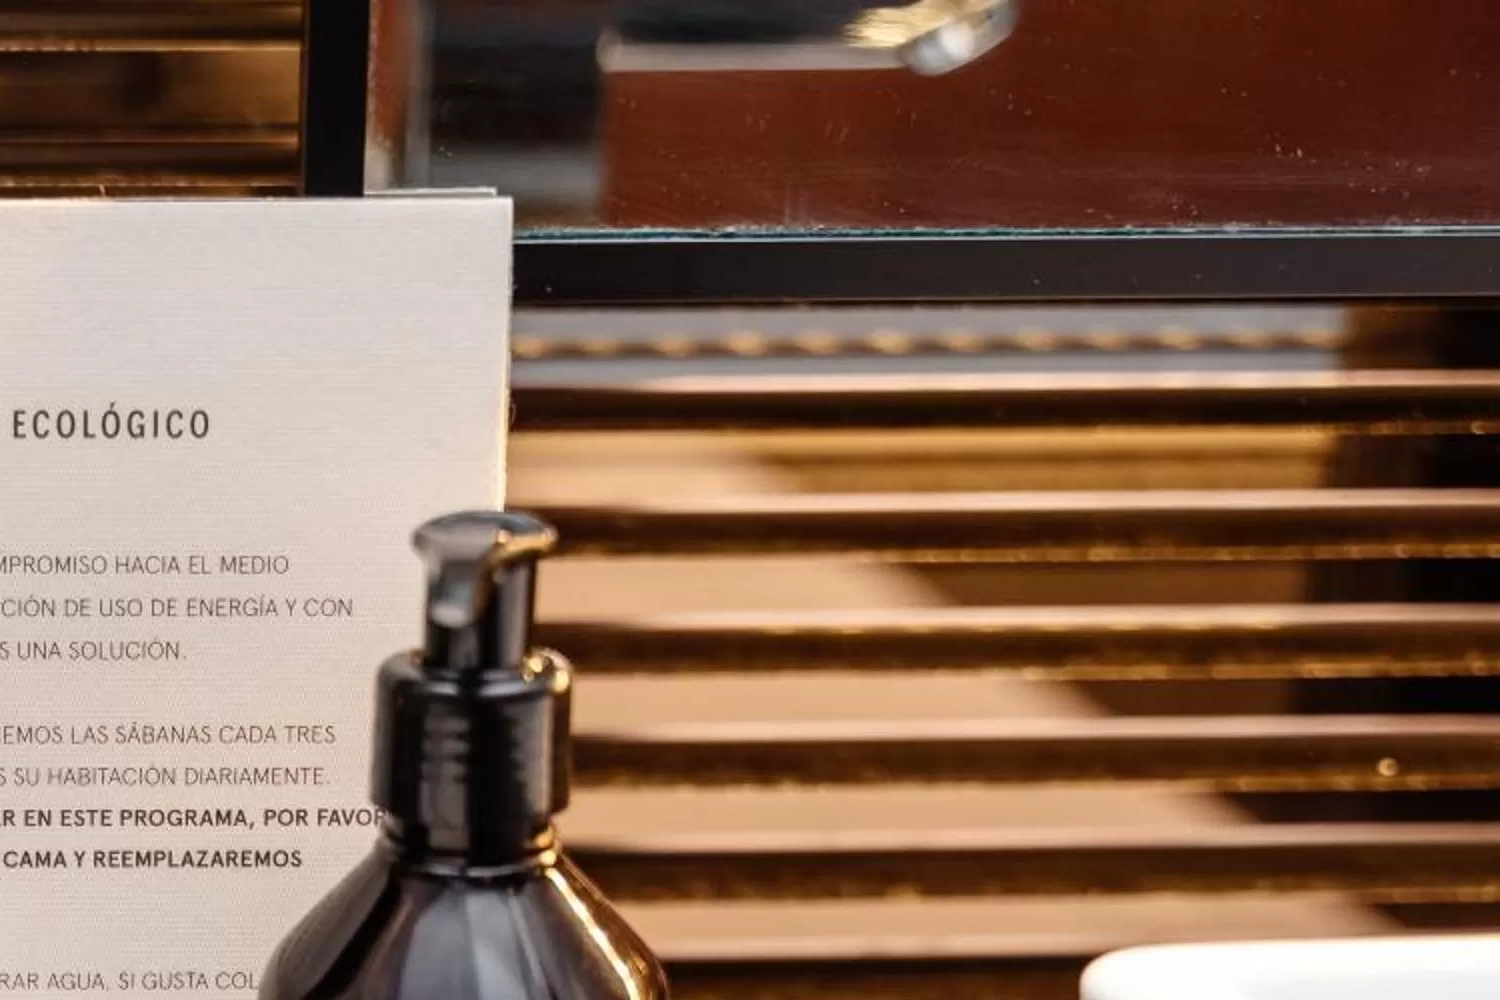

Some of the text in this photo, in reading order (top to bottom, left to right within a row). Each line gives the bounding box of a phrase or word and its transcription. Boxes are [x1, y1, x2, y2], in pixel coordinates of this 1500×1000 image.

[12, 402, 210, 439] ECOLÓGICO
[115, 555, 181, 575] HACIA
[188, 555, 211, 575] EL
[219, 555, 290, 575] MEDIO
[64, 598, 91, 618] DE
[98, 598, 144, 618] USO
[150, 597, 177, 618] DE
[186, 594, 279, 618] ENERGÍA
[285, 598, 297, 617] Y
[302, 597, 353, 617] CON
[16, 641, 62, 661] UNA
[68, 636, 188, 661] SOLUCIÓN.
[70, 724, 109, 745] LAS
[115, 721, 212, 745] SÁBANAS
[218, 724, 278, 744] CADA
[284, 724, 336, 744] TRES
[13, 767, 40, 787] SU
[47, 765, 177, 787] HABITACIÓN
[184, 766, 331, 786] DIARIAMENTE.
[23, 809, 52, 827] EN
[60, 808, 112, 827] ESTE
[119, 808, 255, 830] PROGRAMA,
[263, 808, 309, 827] POR
[2, 850, 67, 869] CAMA
[73, 850, 86, 868] Y
[93, 849, 303, 868] REEMPLAZAREMOS
[118, 970, 136, 991] SI
[141, 970, 209, 991] GUSTA
